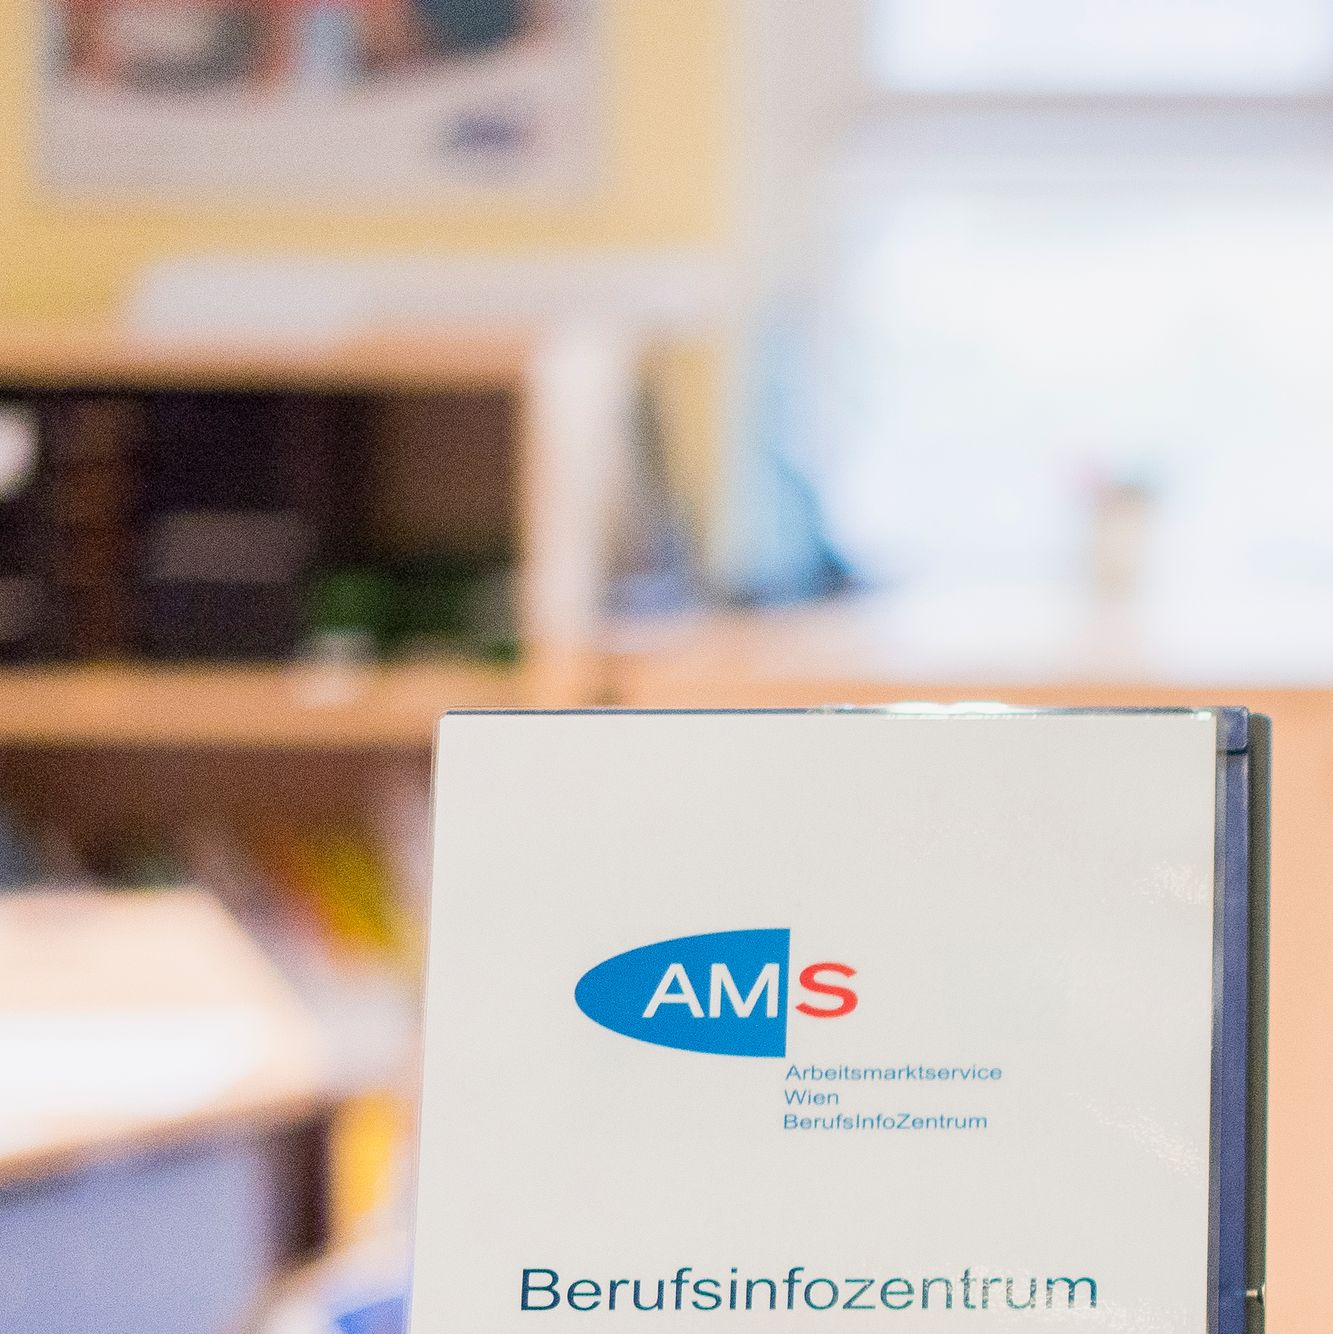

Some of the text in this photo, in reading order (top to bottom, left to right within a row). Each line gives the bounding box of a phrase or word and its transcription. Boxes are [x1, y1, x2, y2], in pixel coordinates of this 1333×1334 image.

[642, 962, 859, 1018] AMS
[785, 1064, 1002, 1081] Arbeitsmarktservice
[784, 1089, 839, 1105] Wien
[783, 1113, 988, 1130] BerufsInfoZentrum
[519, 1266, 1098, 1312] Berufsinfozentrum
